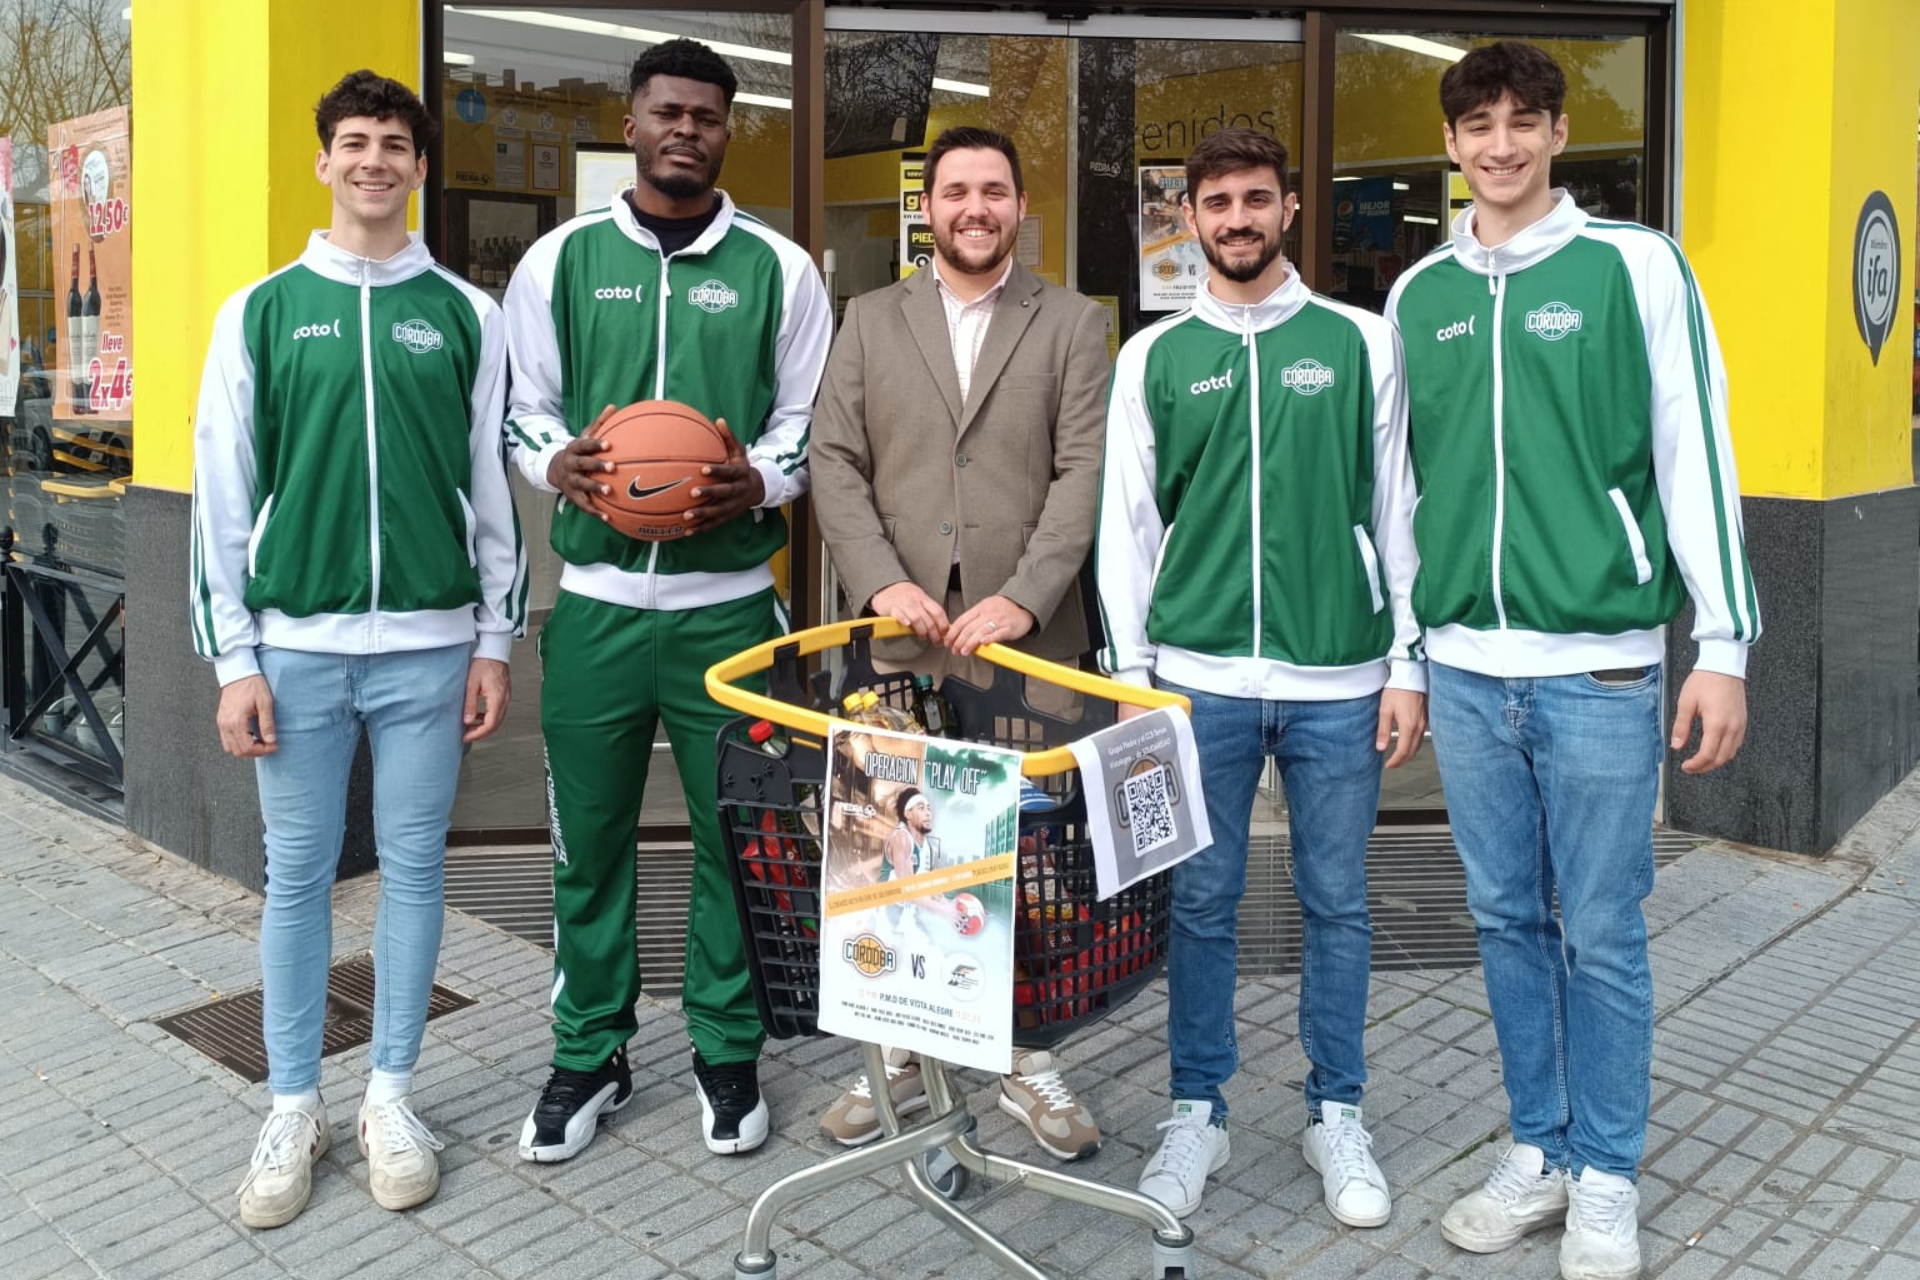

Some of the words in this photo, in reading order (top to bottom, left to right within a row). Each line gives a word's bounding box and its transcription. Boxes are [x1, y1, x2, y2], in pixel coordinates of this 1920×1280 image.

[1136, 104, 1275, 151] enidos
[911, 232, 935, 243] PIED
[1867, 254, 1888, 304] ifa
[845, 942, 894, 969] CORDOBA
[910, 953, 926, 980] VS
[899, 996, 909, 1006] DE
[909, 998, 929, 1012] VISTA
[928, 1003, 954, 1018] ALEGRE
